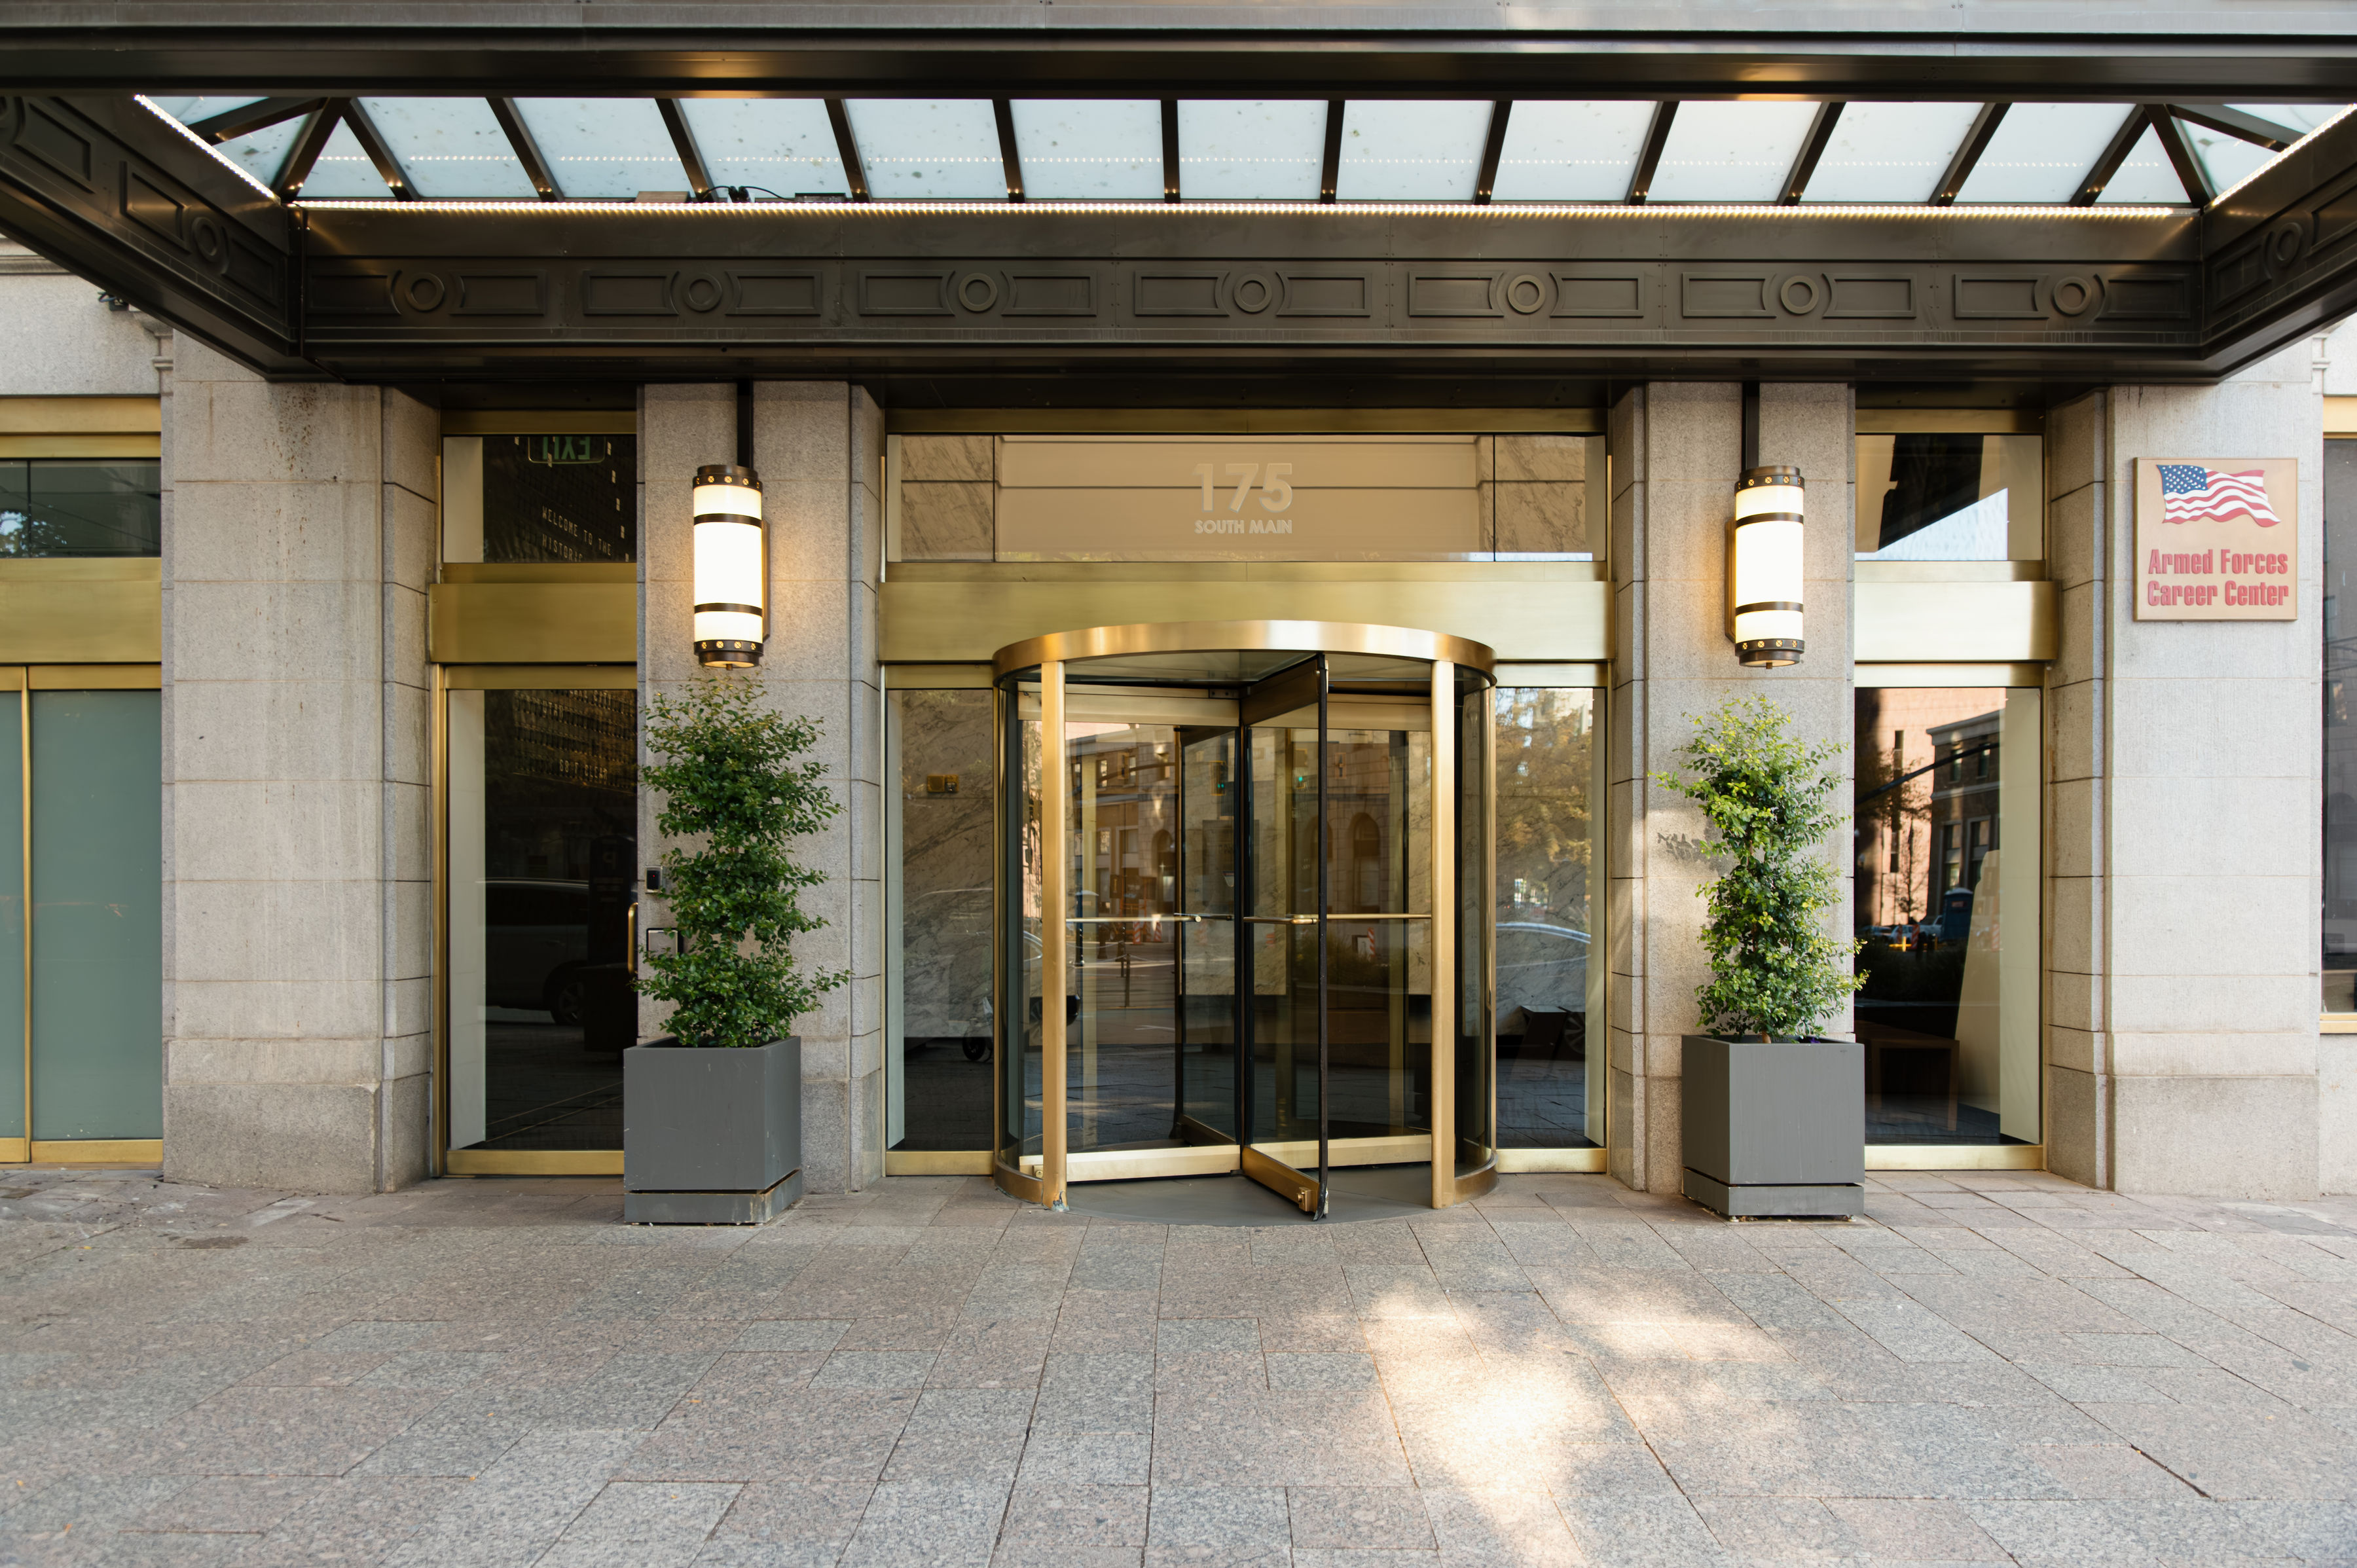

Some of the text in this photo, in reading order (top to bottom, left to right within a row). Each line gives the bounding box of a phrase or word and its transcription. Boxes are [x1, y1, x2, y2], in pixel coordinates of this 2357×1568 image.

[1192, 463, 1293, 513] 175
[542, 505, 612, 556] WELCOME TO THE
[1194, 519, 1292, 534] SOUTH MAIN
[2148, 549, 2288, 574] Armed Forces
[2147, 580, 2289, 606] Career Center
[585, 764, 608, 780] CLEAR
